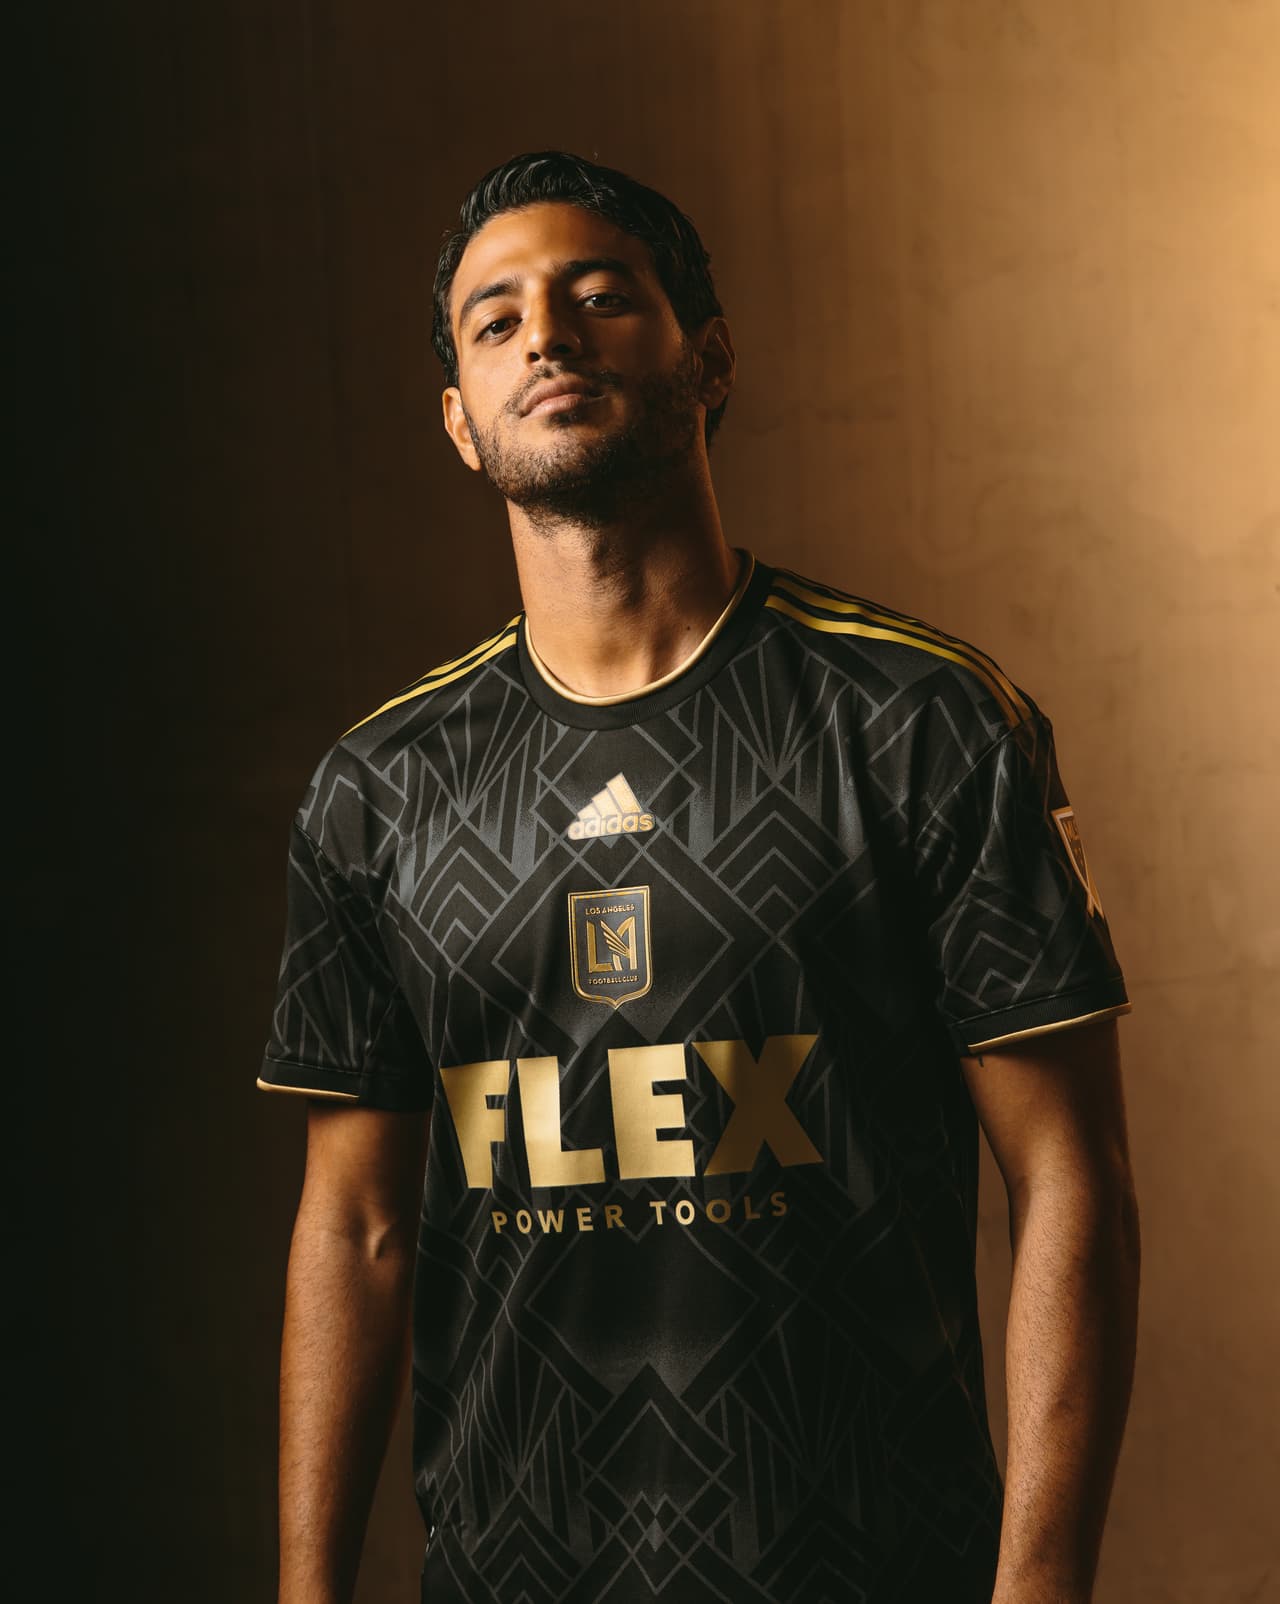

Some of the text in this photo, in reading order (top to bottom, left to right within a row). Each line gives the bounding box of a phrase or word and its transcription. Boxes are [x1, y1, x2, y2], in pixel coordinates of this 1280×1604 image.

[568, 813, 655, 840] adidas
[585, 904, 635, 915] LOS ANGELES
[440, 1034, 824, 1189] FLEX
[491, 1191, 787, 1234] POWER TOOLS
